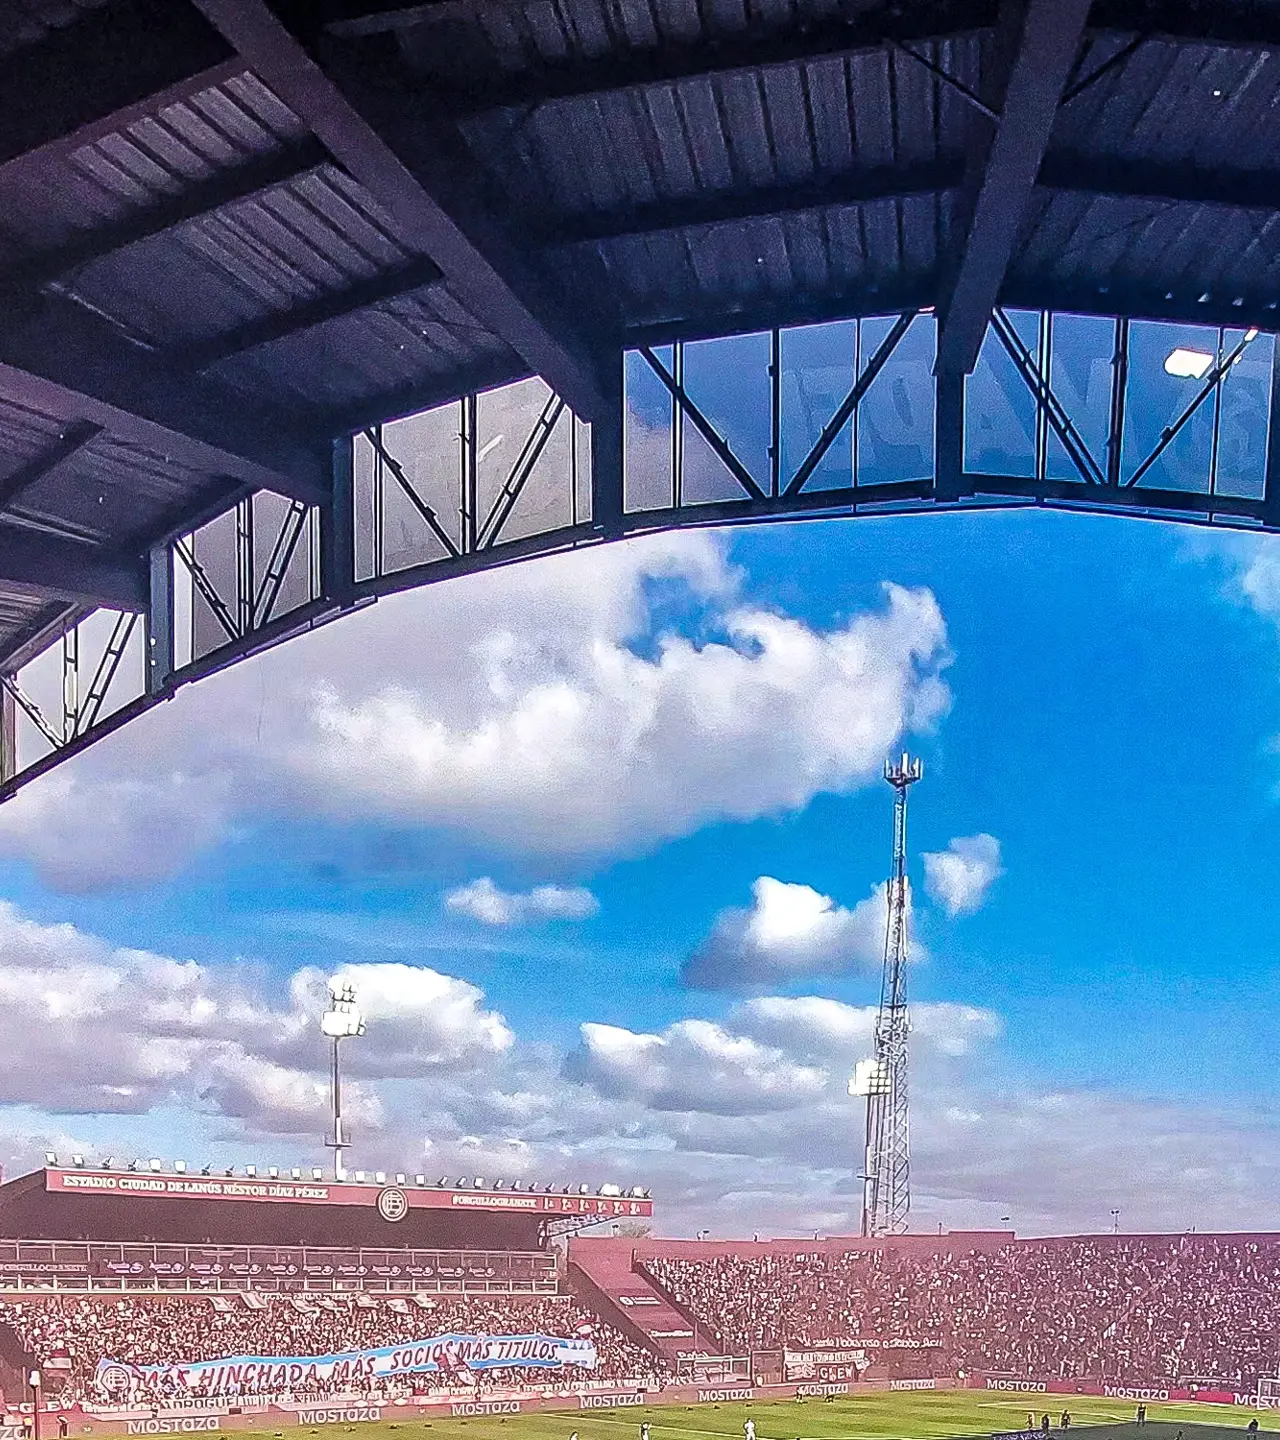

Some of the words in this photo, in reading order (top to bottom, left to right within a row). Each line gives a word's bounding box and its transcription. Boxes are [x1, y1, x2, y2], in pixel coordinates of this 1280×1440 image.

[62, 1175, 116, 1188] ESTADIO
[119, 1178, 165, 1191] CIUDAD
[168, 1181, 185, 1192] DE
[185, 1181, 221, 1194] LANÚS
[224, 1183, 267, 1195] NÉSTOR
[269, 1185, 294, 1197] DÍAZ
[295, 1187, 329, 1199] PÉREZ
[198, 1362, 321, 1394] HINCHADA
[331, 1354, 376, 1380] MÁS
[390, 1340, 453, 1370] SOCIOS
[458, 1337, 491, 1361] MÁS
